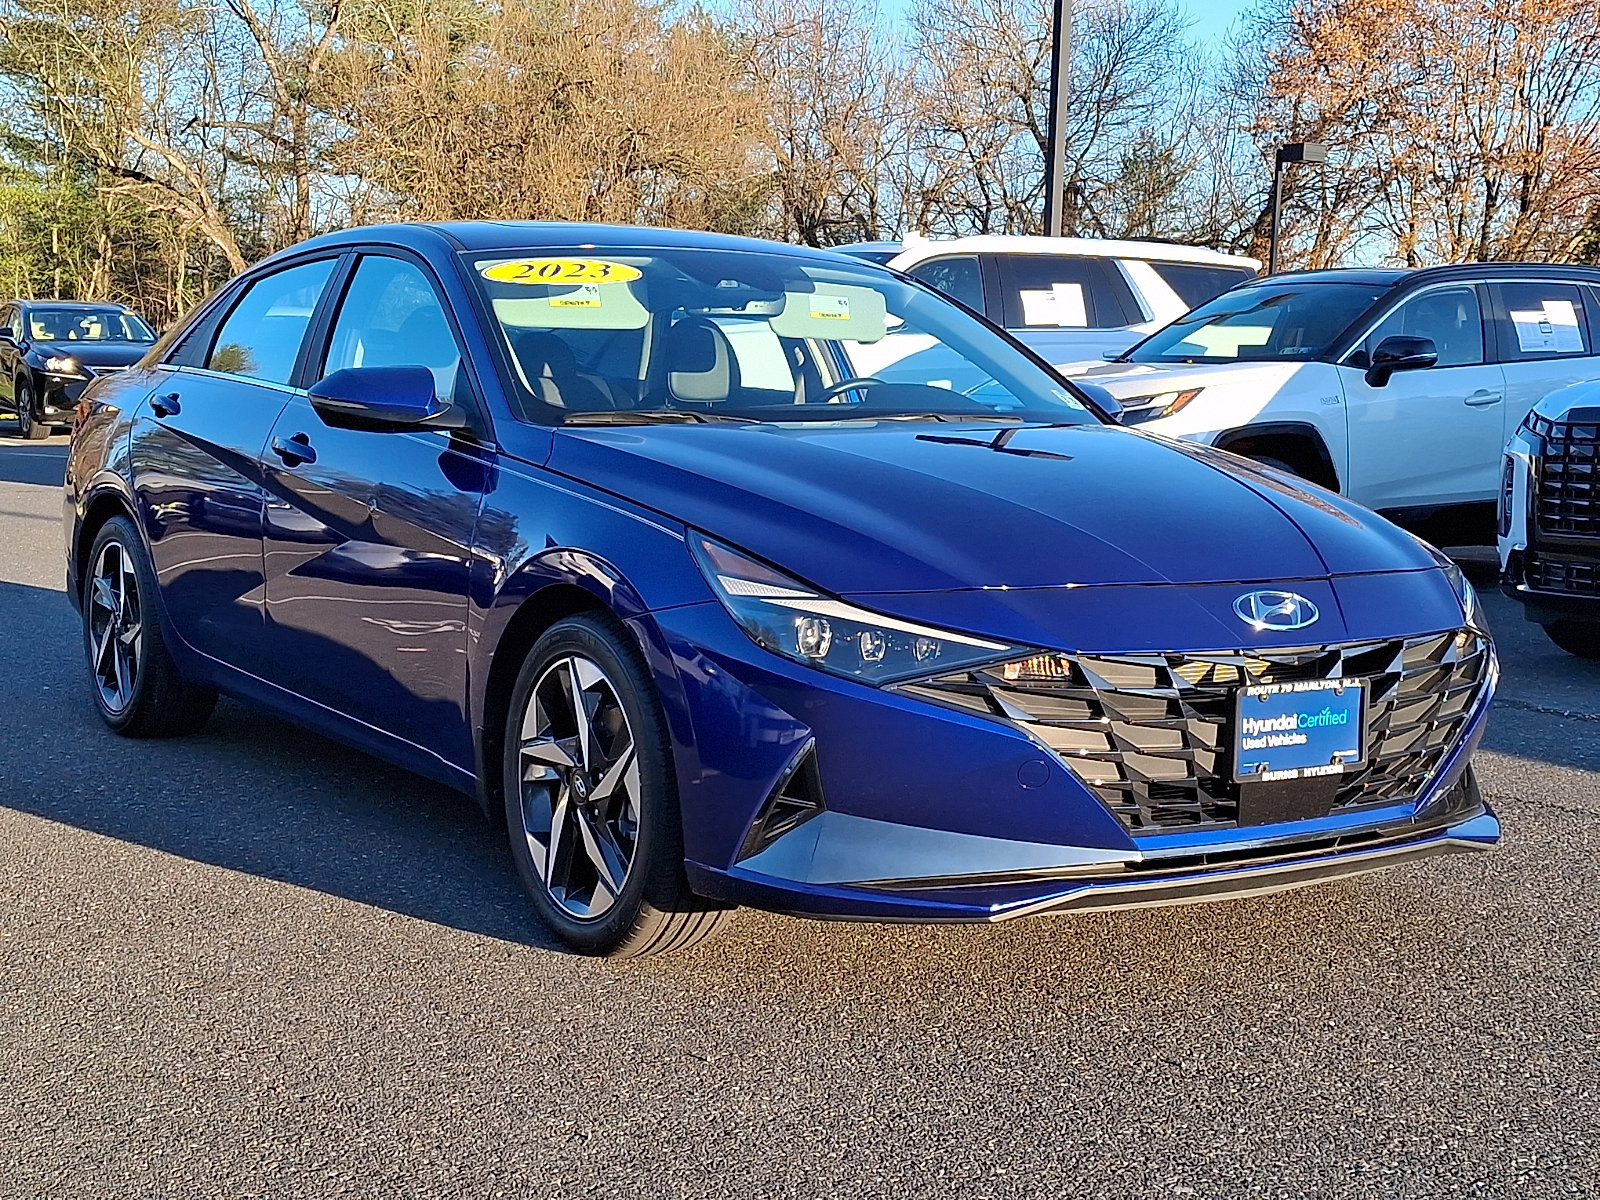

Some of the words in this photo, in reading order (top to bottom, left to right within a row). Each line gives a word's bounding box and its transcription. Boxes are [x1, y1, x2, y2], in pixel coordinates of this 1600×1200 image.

[513, 264, 611, 279] 2023
[1247, 685, 1279, 697] ROUTE
[1242, 713, 1298, 736] Hyundai
[1298, 707, 1348, 728] Certified
[1242, 736, 1267, 750] Used
[1268, 733, 1307, 747] Vehicles
